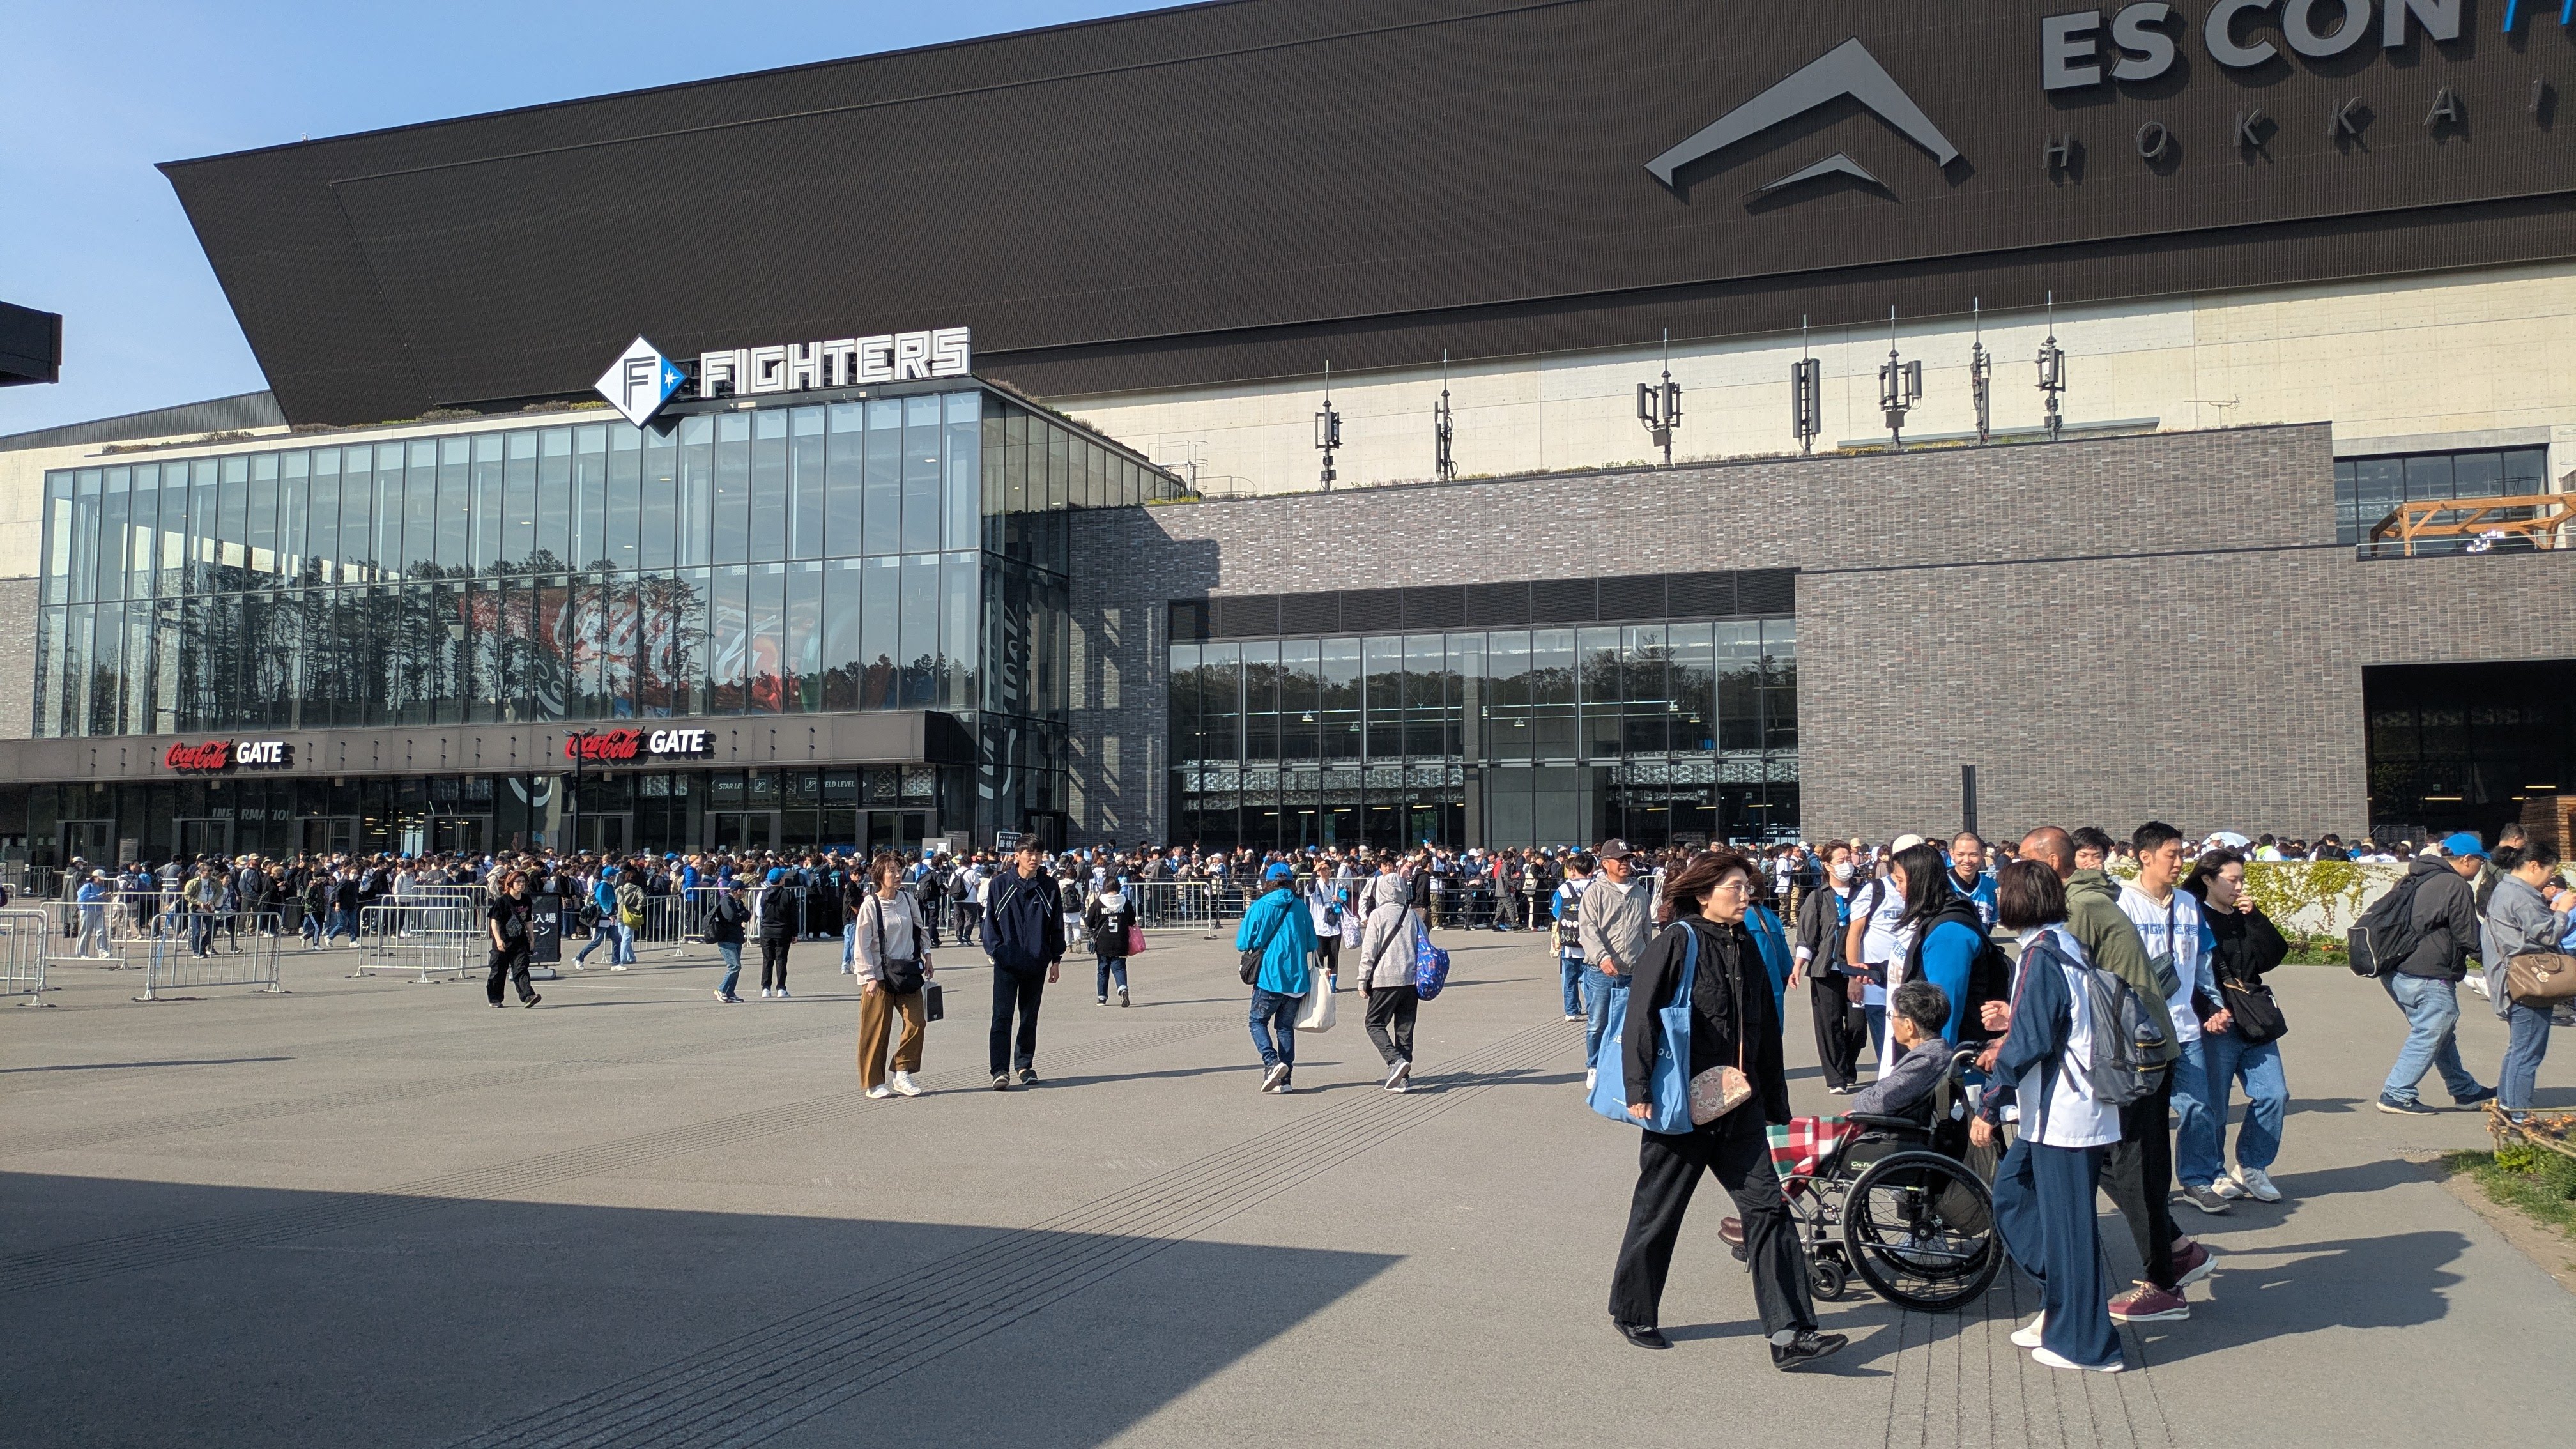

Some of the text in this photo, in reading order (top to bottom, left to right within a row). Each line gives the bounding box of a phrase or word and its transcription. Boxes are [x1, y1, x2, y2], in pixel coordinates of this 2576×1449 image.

[2043, 0, 2460, 91] ES CON
[700, 326, 971, 398] FIGHTERS
[164, 739, 284, 770] Coca-Cola GATE
[650, 729, 705, 754] GATE
[532, 912, 556, 924] 入場
[1108, 916, 1118, 933] 5
